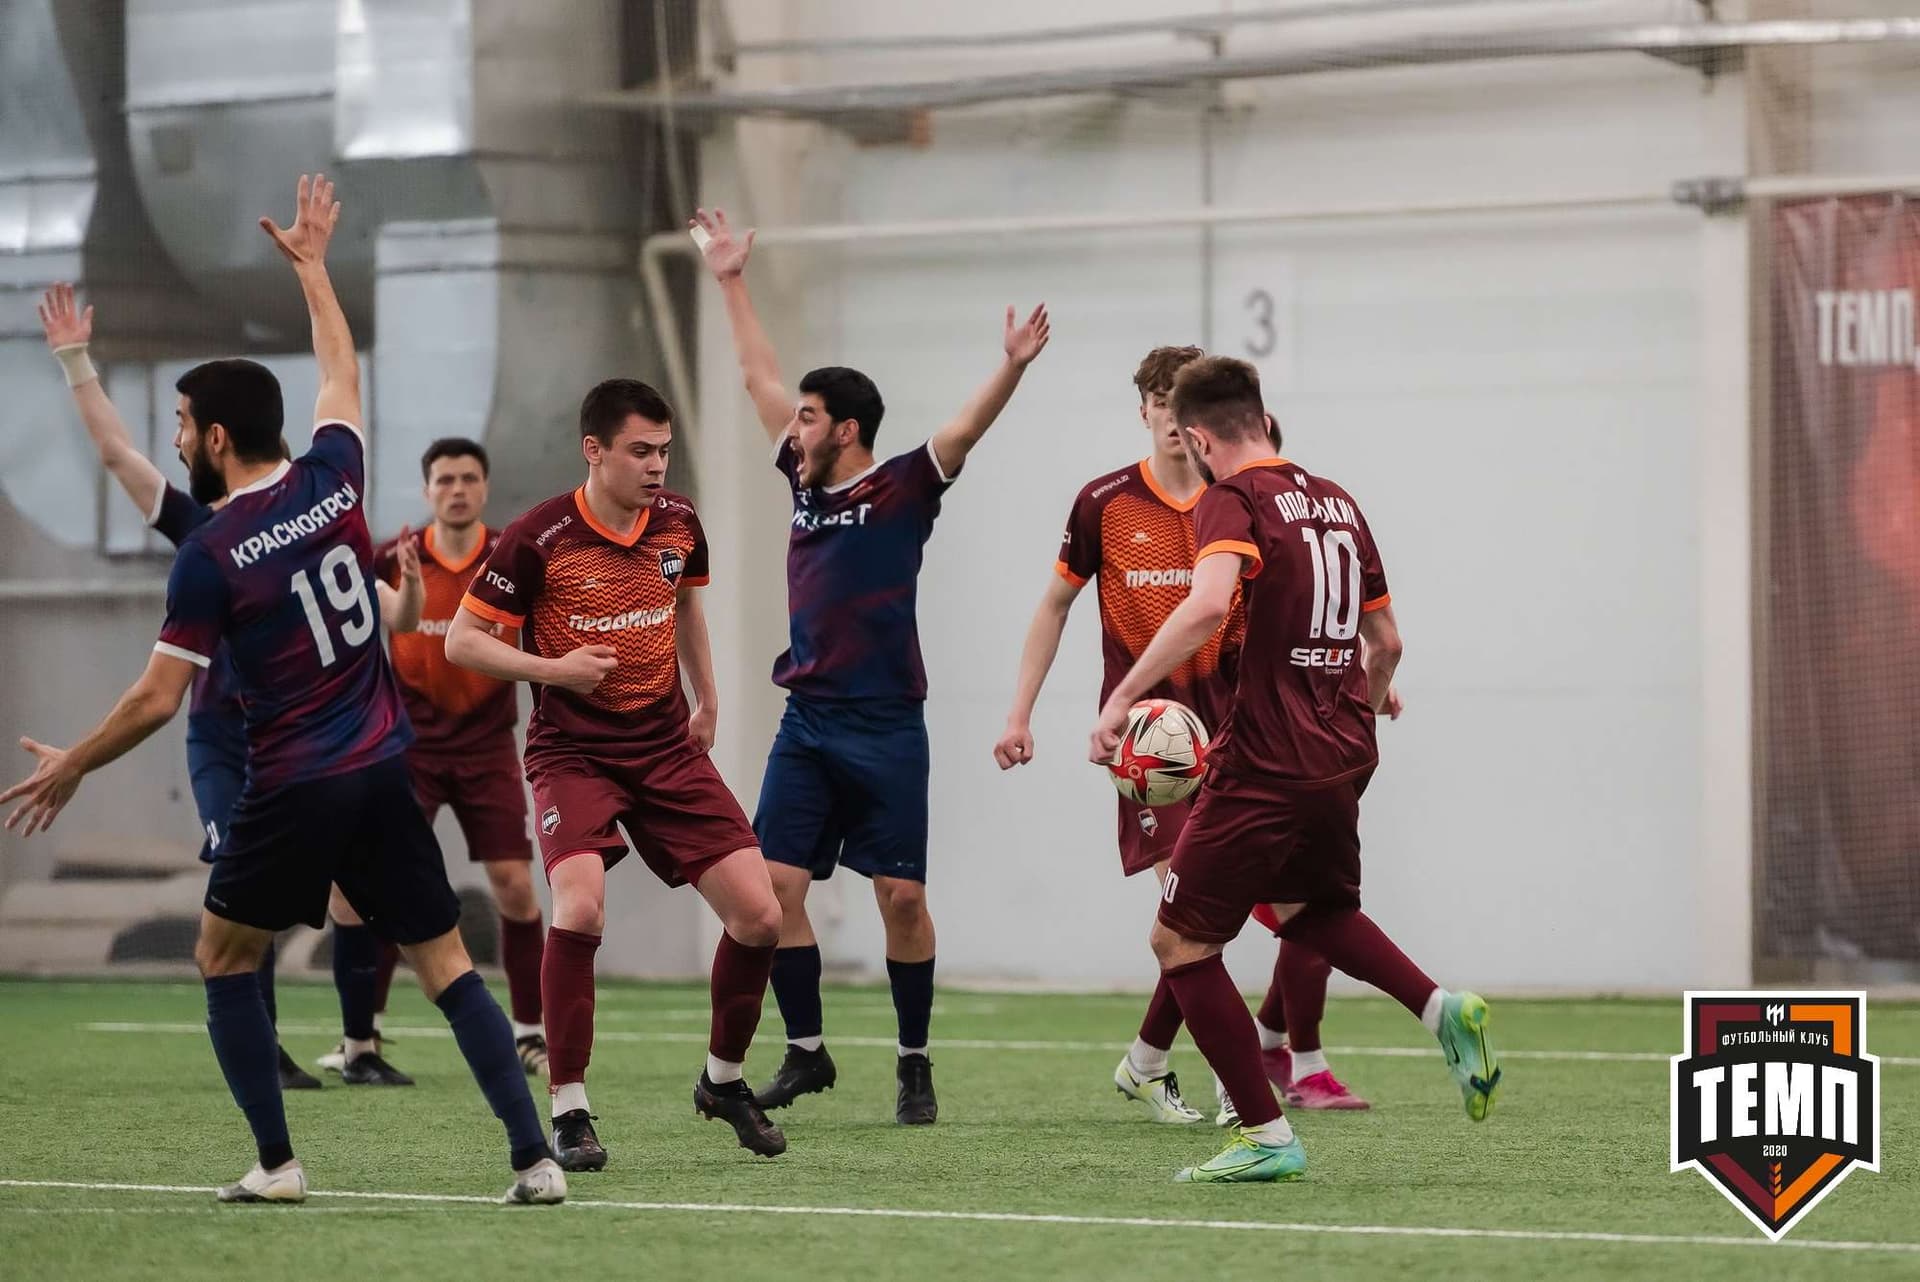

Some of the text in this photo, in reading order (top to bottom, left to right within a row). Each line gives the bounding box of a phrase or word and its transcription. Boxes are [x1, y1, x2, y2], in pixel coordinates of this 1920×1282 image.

[1242, 286, 1278, 358] 3
[291, 544, 374, 668] 19
[1301, 527, 1361, 640] 10
